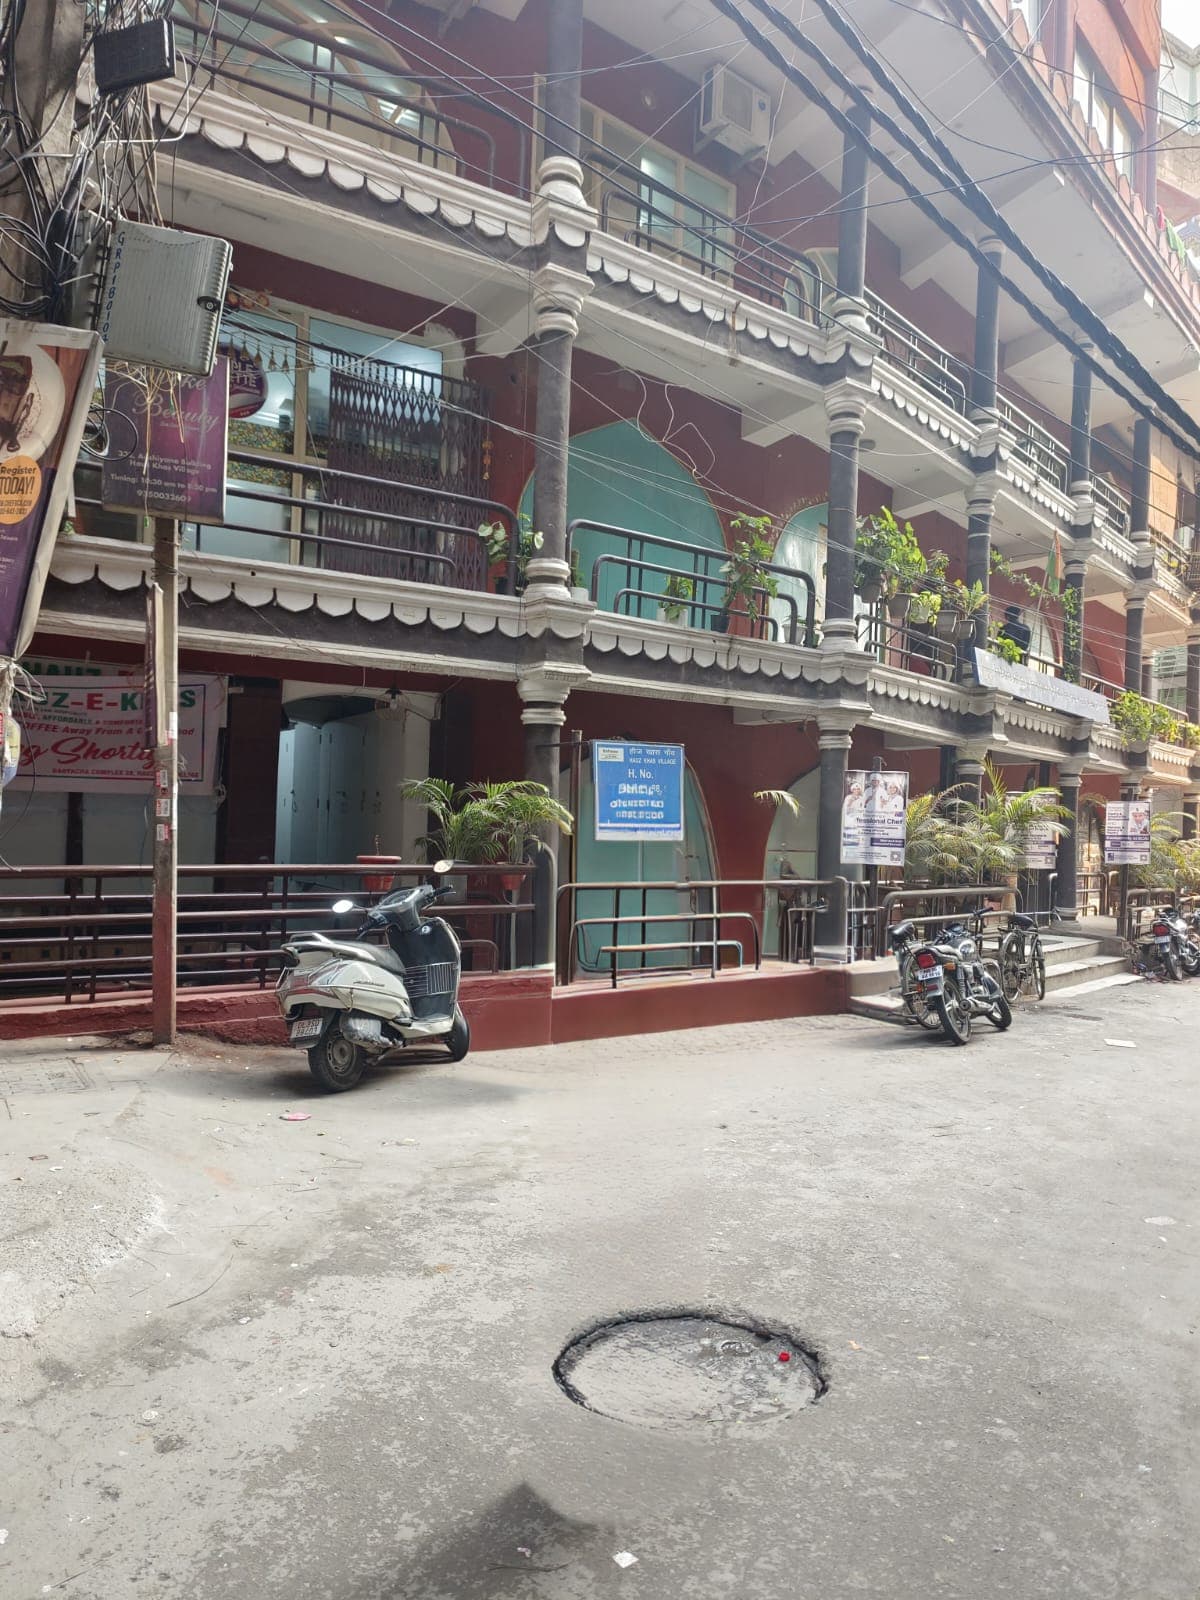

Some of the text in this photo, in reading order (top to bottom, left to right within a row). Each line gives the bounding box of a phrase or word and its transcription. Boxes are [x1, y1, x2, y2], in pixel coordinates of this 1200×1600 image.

[0, 466, 37, 476] Register
[0, 476, 35, 494] TODAY!
[62, 726, 94, 737] Away
[95, 727, 124, 736] From
[628, 768, 654, 779] H. No.
